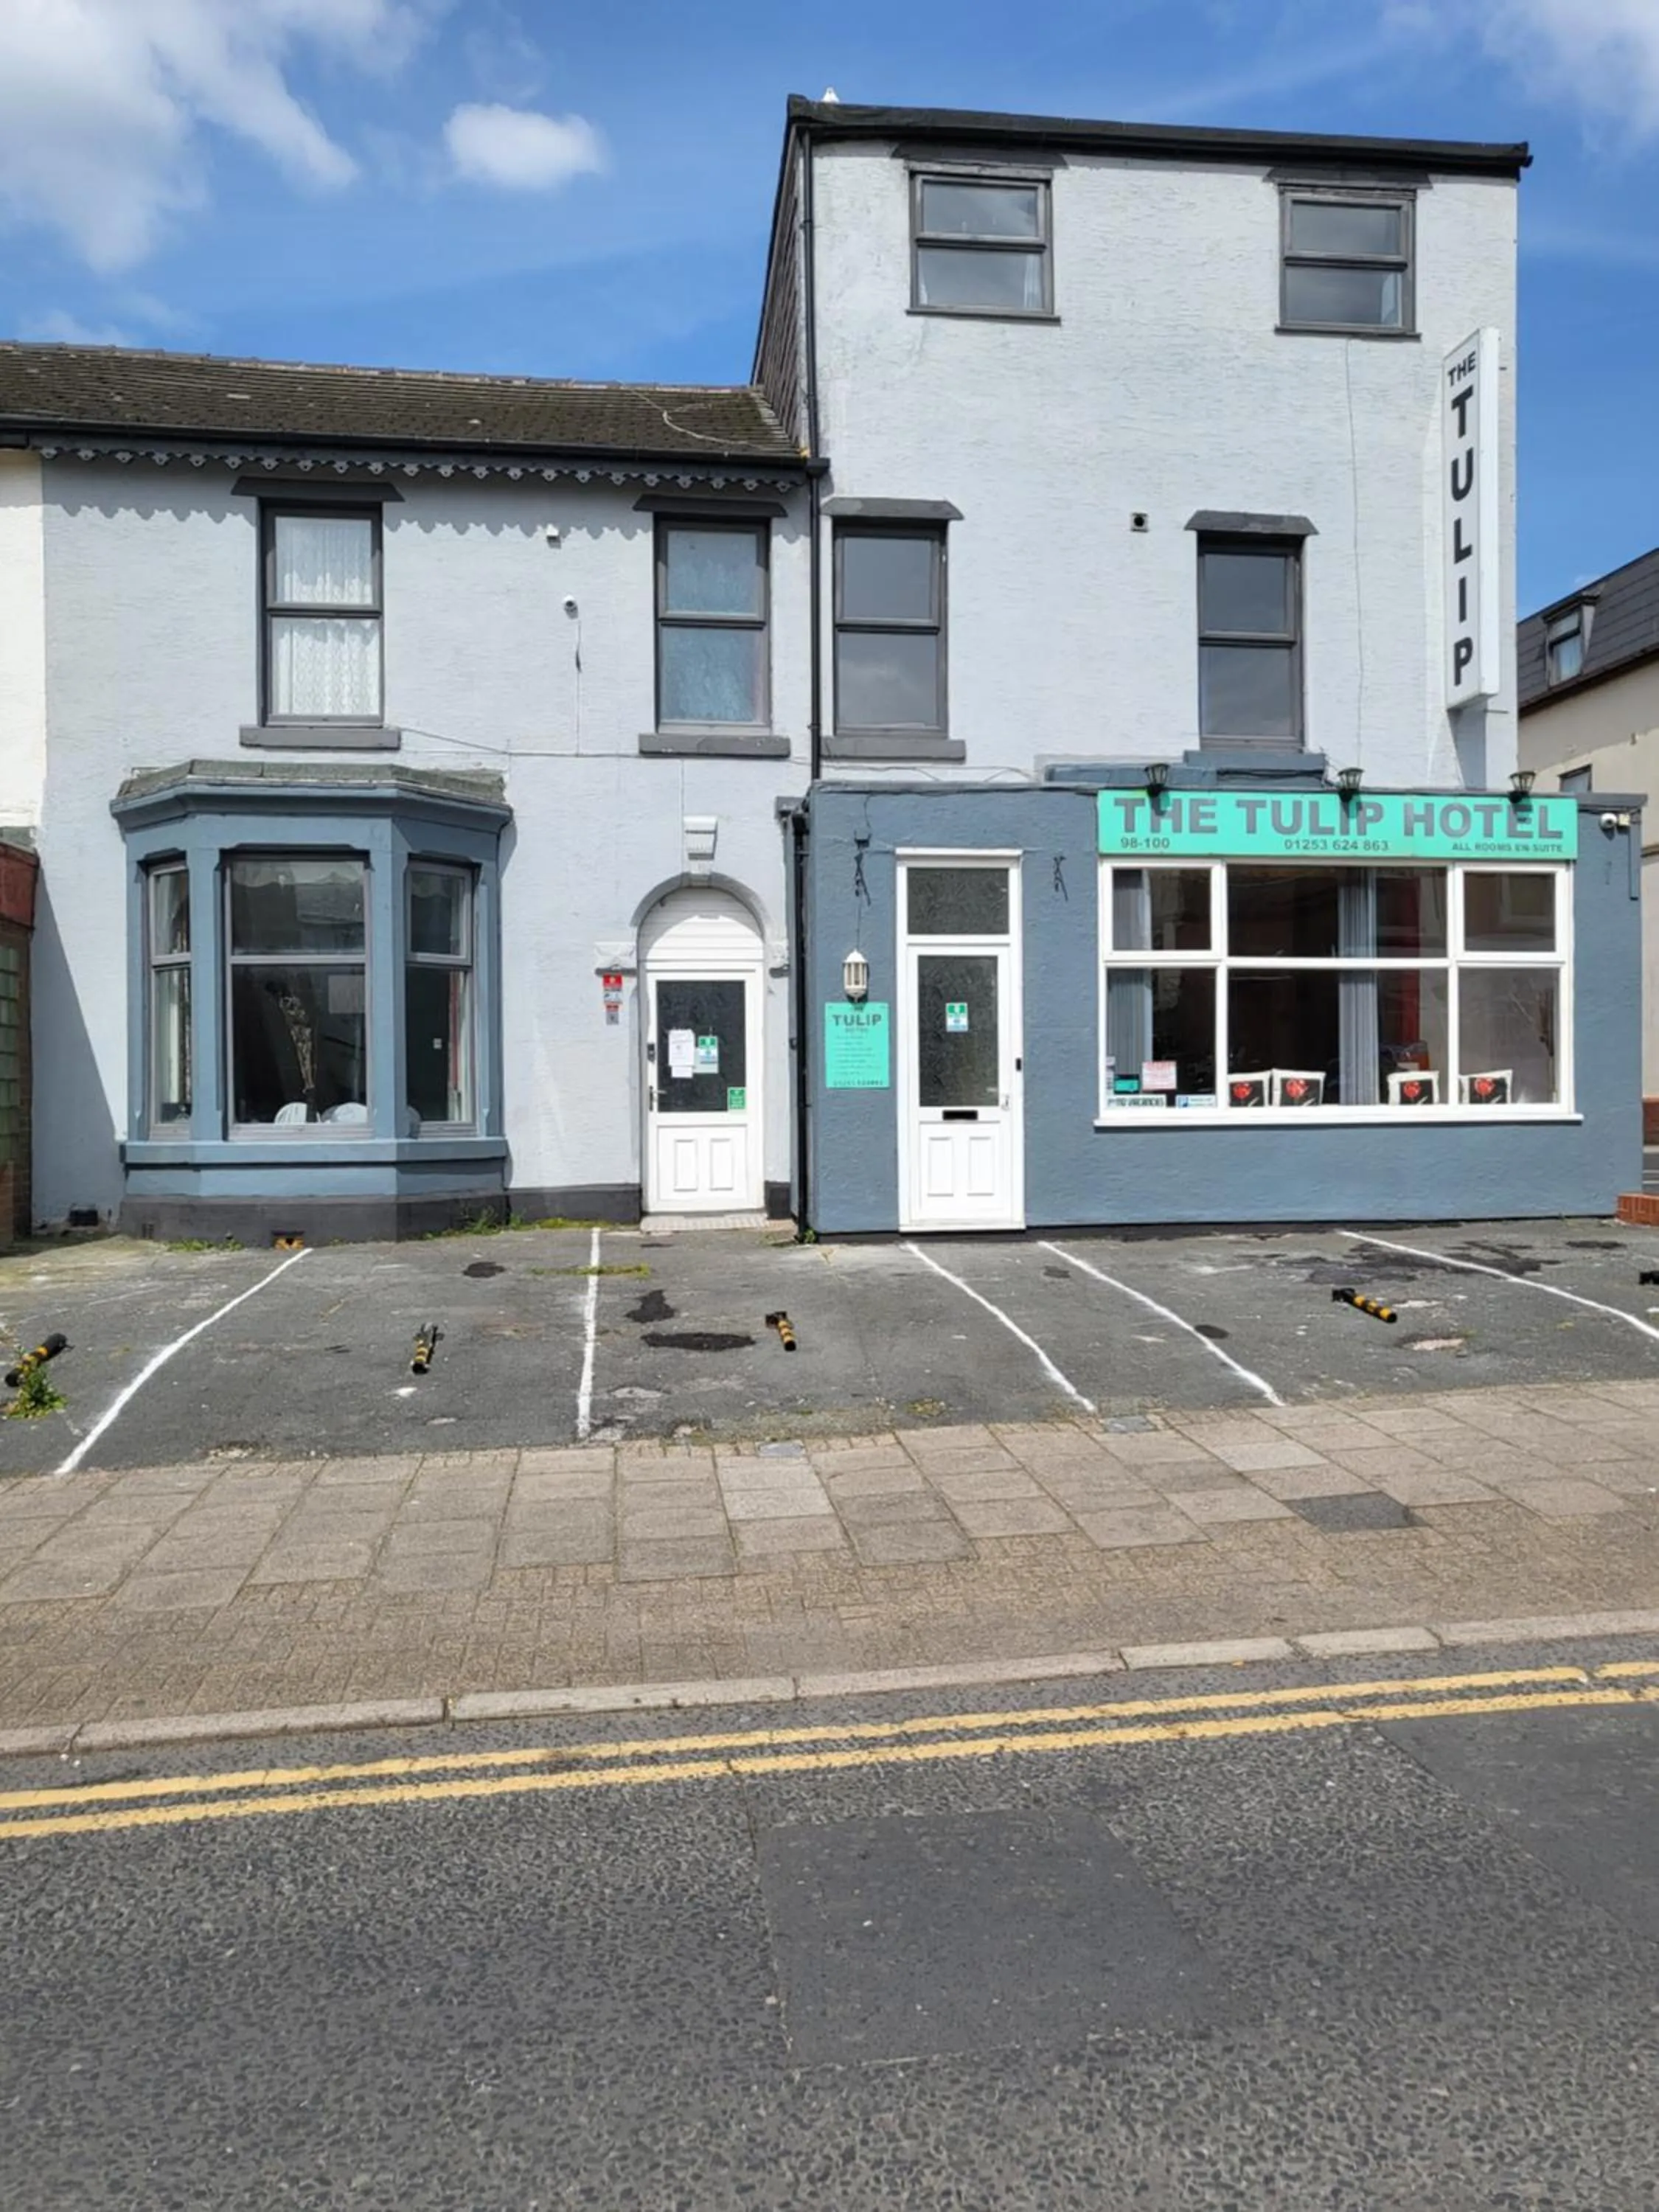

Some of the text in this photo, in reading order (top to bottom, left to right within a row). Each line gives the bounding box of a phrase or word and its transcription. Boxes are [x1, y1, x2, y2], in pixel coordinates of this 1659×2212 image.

[1447, 351, 1476, 387] THE
[1450, 385, 1474, 686] TULIP
[1114, 798, 1564, 839] THE TULIP HOTEL
[1120, 837, 1171, 849] 98-100
[1284, 839, 1389, 851] 01253 624 863
[1452, 842, 1472, 851] ALL
[1475, 842, 1512, 852] ROOMS
[832, 1014, 882, 1026] TULIP
